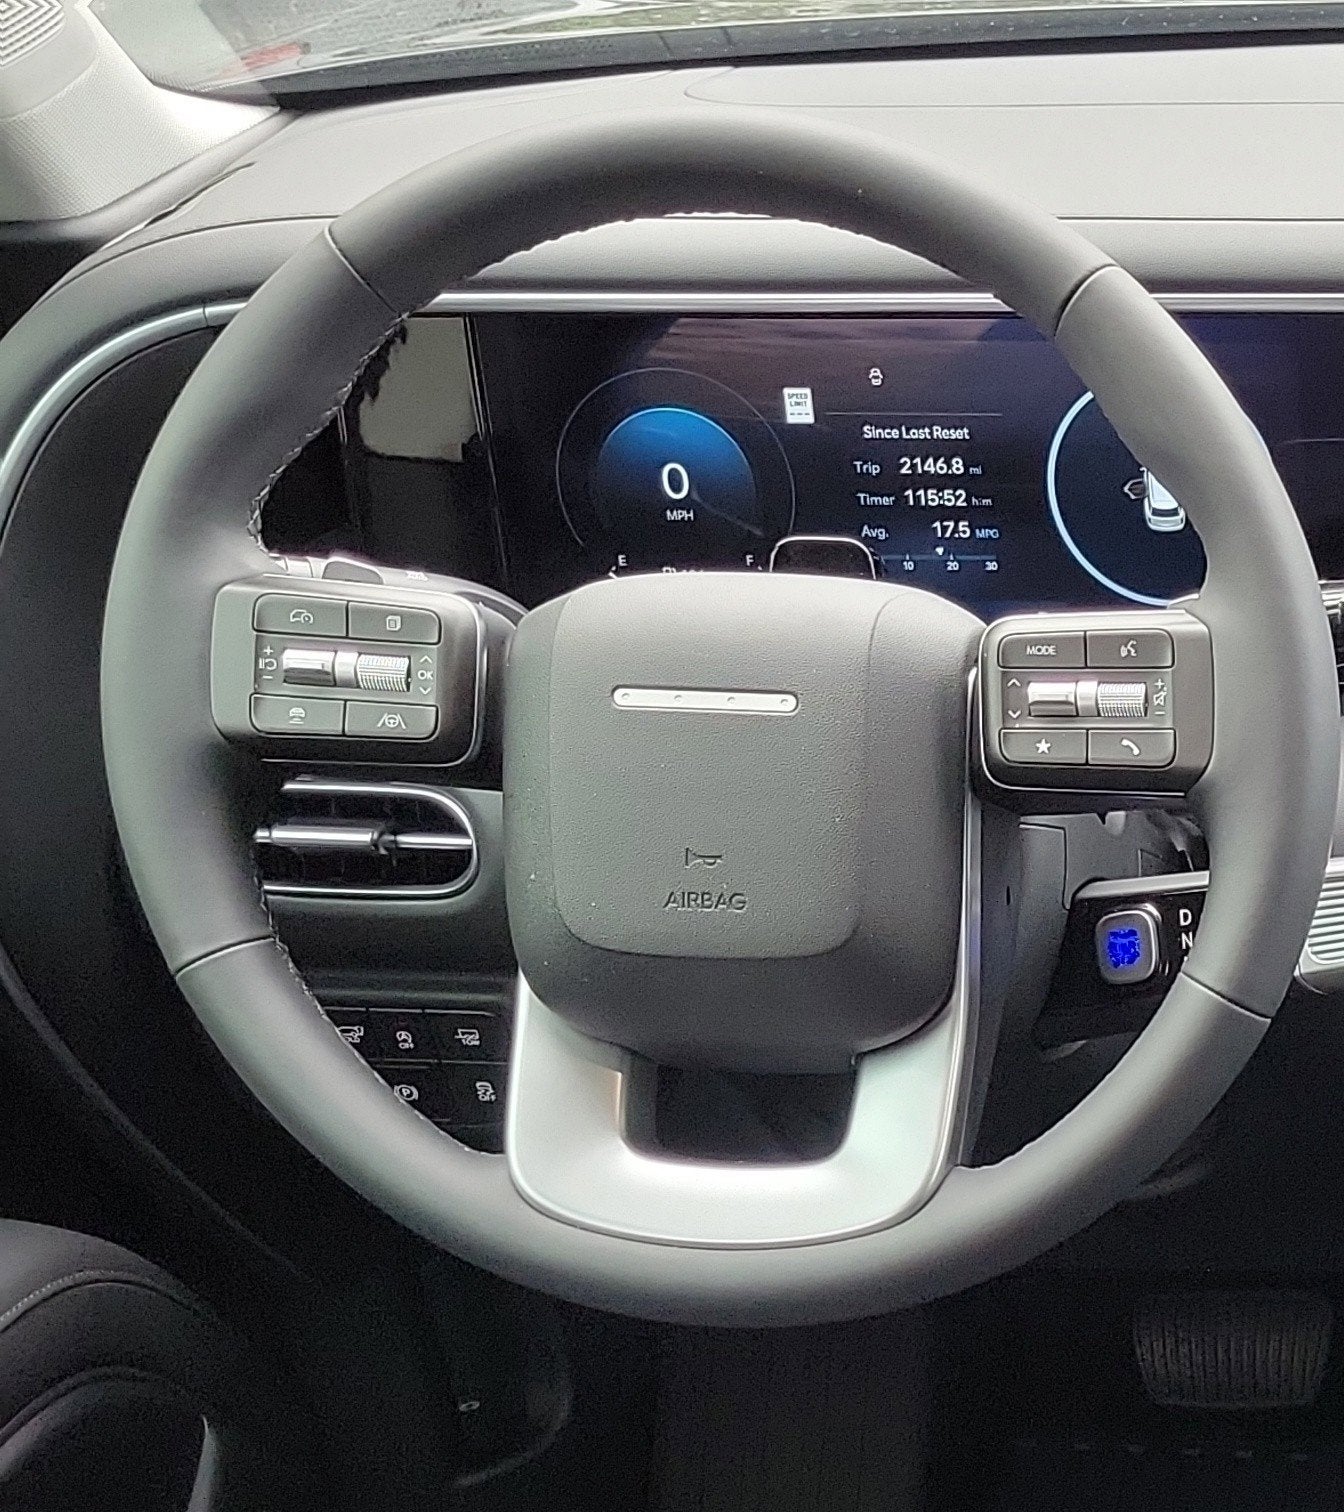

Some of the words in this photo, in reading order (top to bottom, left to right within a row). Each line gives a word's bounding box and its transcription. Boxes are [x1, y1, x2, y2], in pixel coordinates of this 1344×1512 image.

[863, 425, 899, 439] Since
[902, 425, 931, 439] Last
[933, 426, 970, 440] Reset
[853, 461, 881, 475] Trip
[900, 457, 965, 475] 2146.8
[969, 466, 982, 474] mi
[662, 462, 690, 500] 0
[856, 493, 895, 505] Timer
[904, 489, 968, 506] 115:52
[666, 509, 694, 521] MPH
[861, 525, 889, 540] Avg.
[931, 521, 971, 538] 17.5
[975, 529, 999, 538] MPG
[618, 555, 627, 566] E
[746, 555, 754, 566] F
[903, 561, 914, 570] 10
[947, 561, 959, 570] 20
[985, 561, 998, 571] 30
[1026, 645, 1056, 655] MODE
[418, 670, 433, 680] OK
[663, 891, 748, 912] AIRBAG
[1179, 909, 1192, 926] D
[1181, 932, 1193, 949] N
